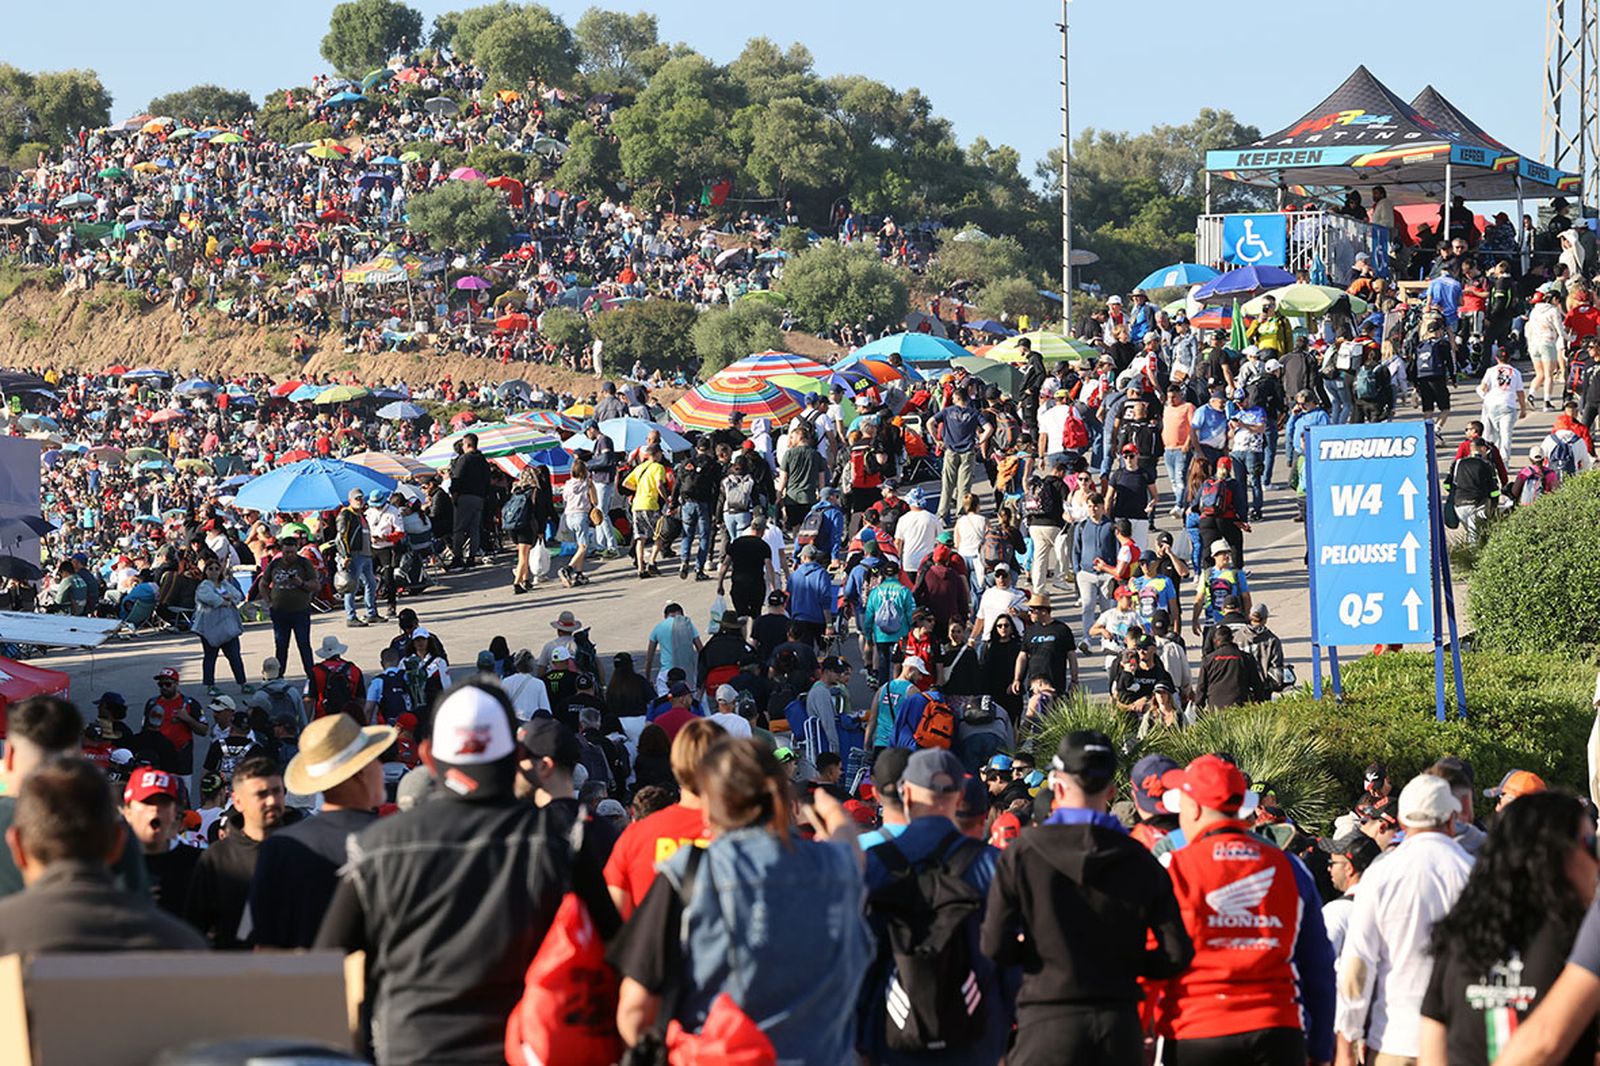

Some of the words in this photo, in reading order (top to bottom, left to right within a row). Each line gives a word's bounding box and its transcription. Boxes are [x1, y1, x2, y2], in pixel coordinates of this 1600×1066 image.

[1236, 150, 1323, 167] KEFREN
[1460, 149, 1486, 162] KEFREN
[1319, 437, 1417, 460] TRIBUNAS
[1330, 483, 1383, 517] W4
[1321, 543, 1398, 566] PELOUSSE
[1339, 592, 1384, 629] Q5
[141, 772, 169, 788] 93
[1207, 914, 1284, 928] HONDA
